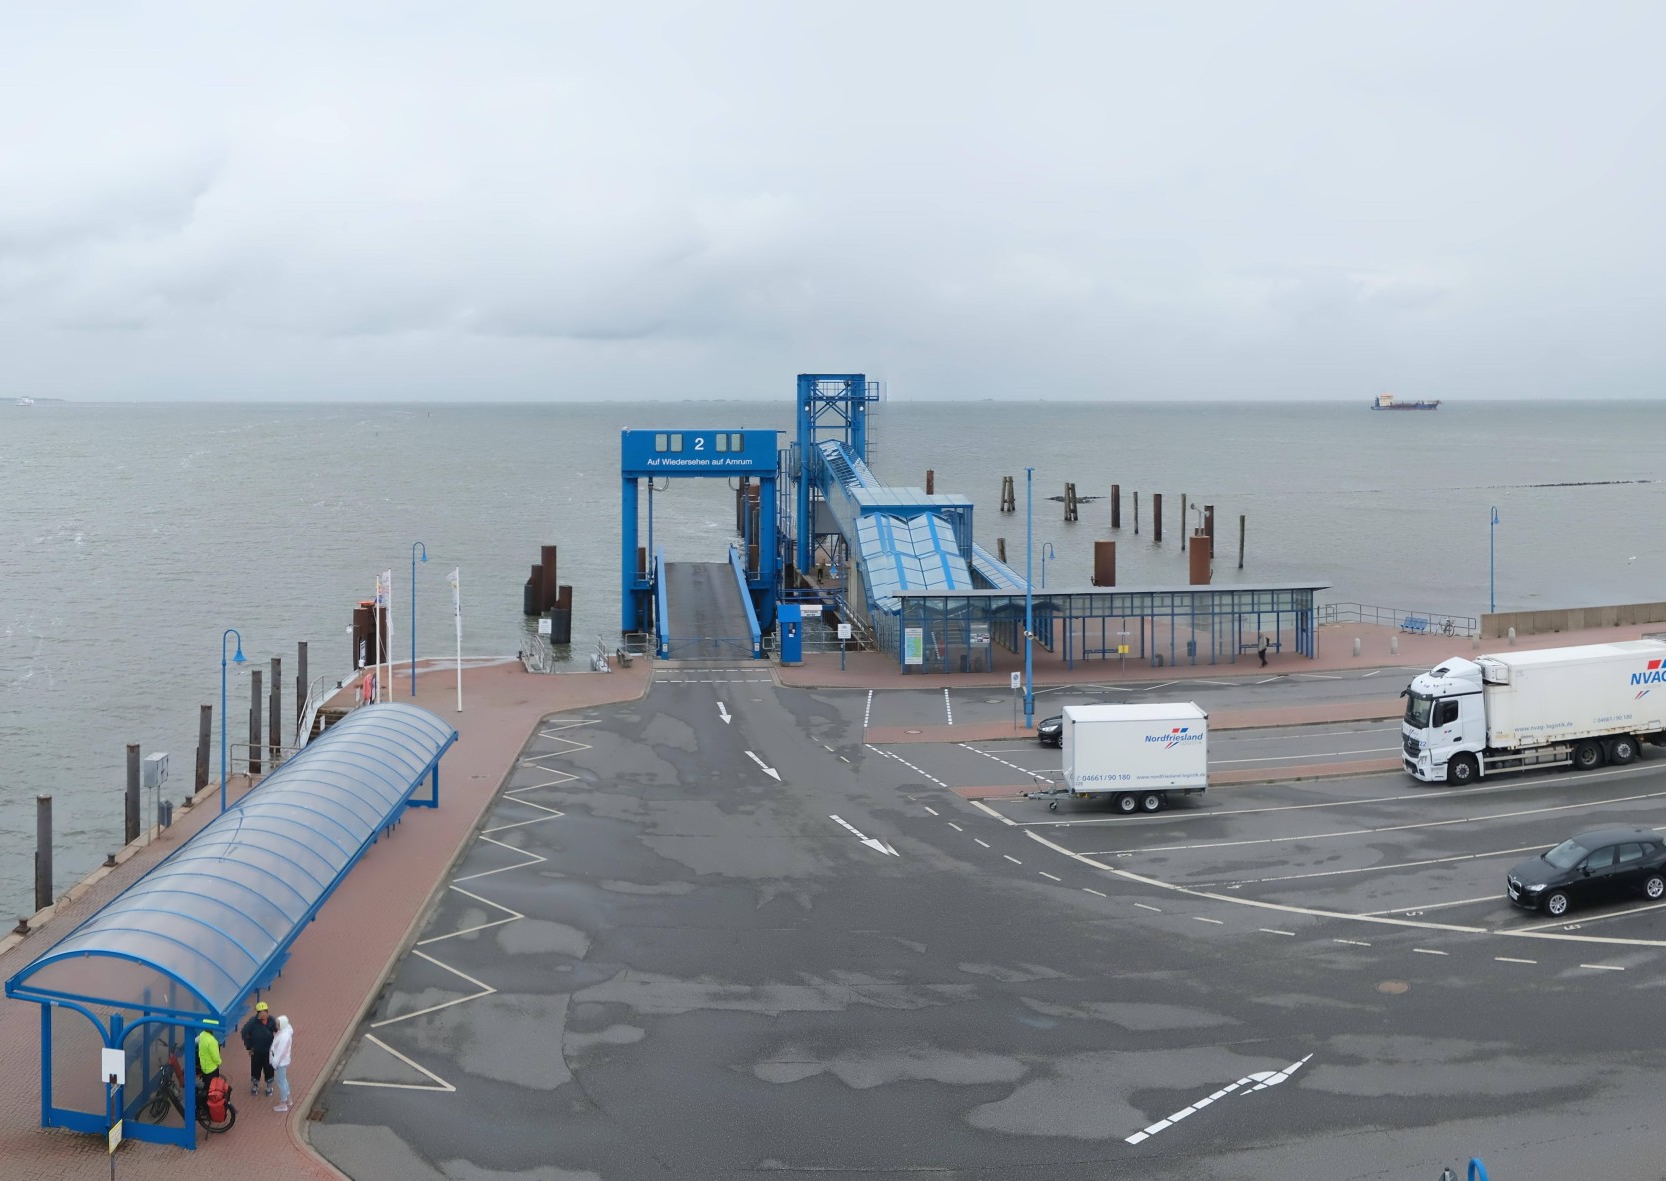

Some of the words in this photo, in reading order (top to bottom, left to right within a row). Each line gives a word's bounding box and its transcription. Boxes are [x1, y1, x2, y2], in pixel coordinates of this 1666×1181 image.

[694, 437, 704, 450] 2
[662, 458, 710, 466] Wiedersehen
[712, 458, 723, 466] auf
[725, 458, 753, 466] Amrum
[1145, 733, 1203, 742] Nordfriesland
